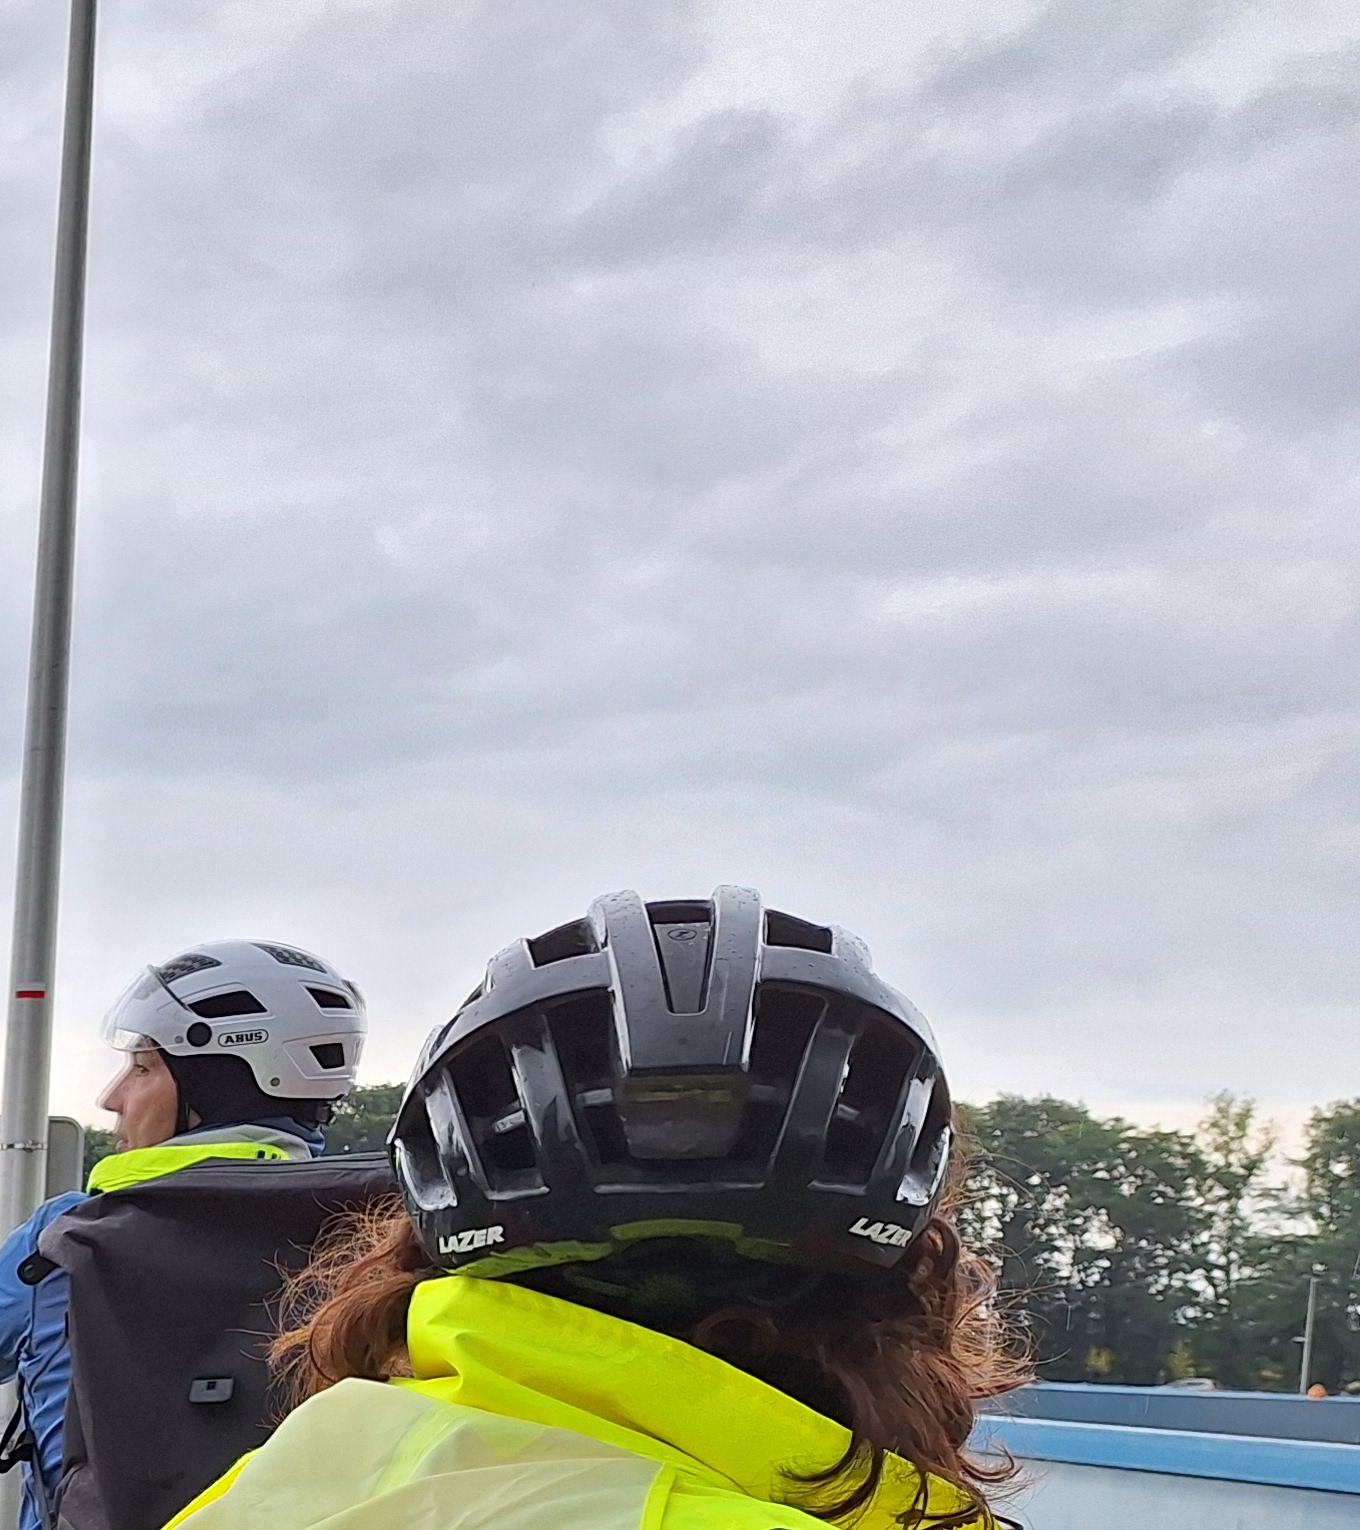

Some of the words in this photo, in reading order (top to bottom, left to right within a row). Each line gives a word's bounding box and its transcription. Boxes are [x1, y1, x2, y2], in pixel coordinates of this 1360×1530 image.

[224, 1031, 263, 1045] ABUS
[438, 1225, 505, 1255] LAZER
[848, 1217, 912, 1249] LAZER
